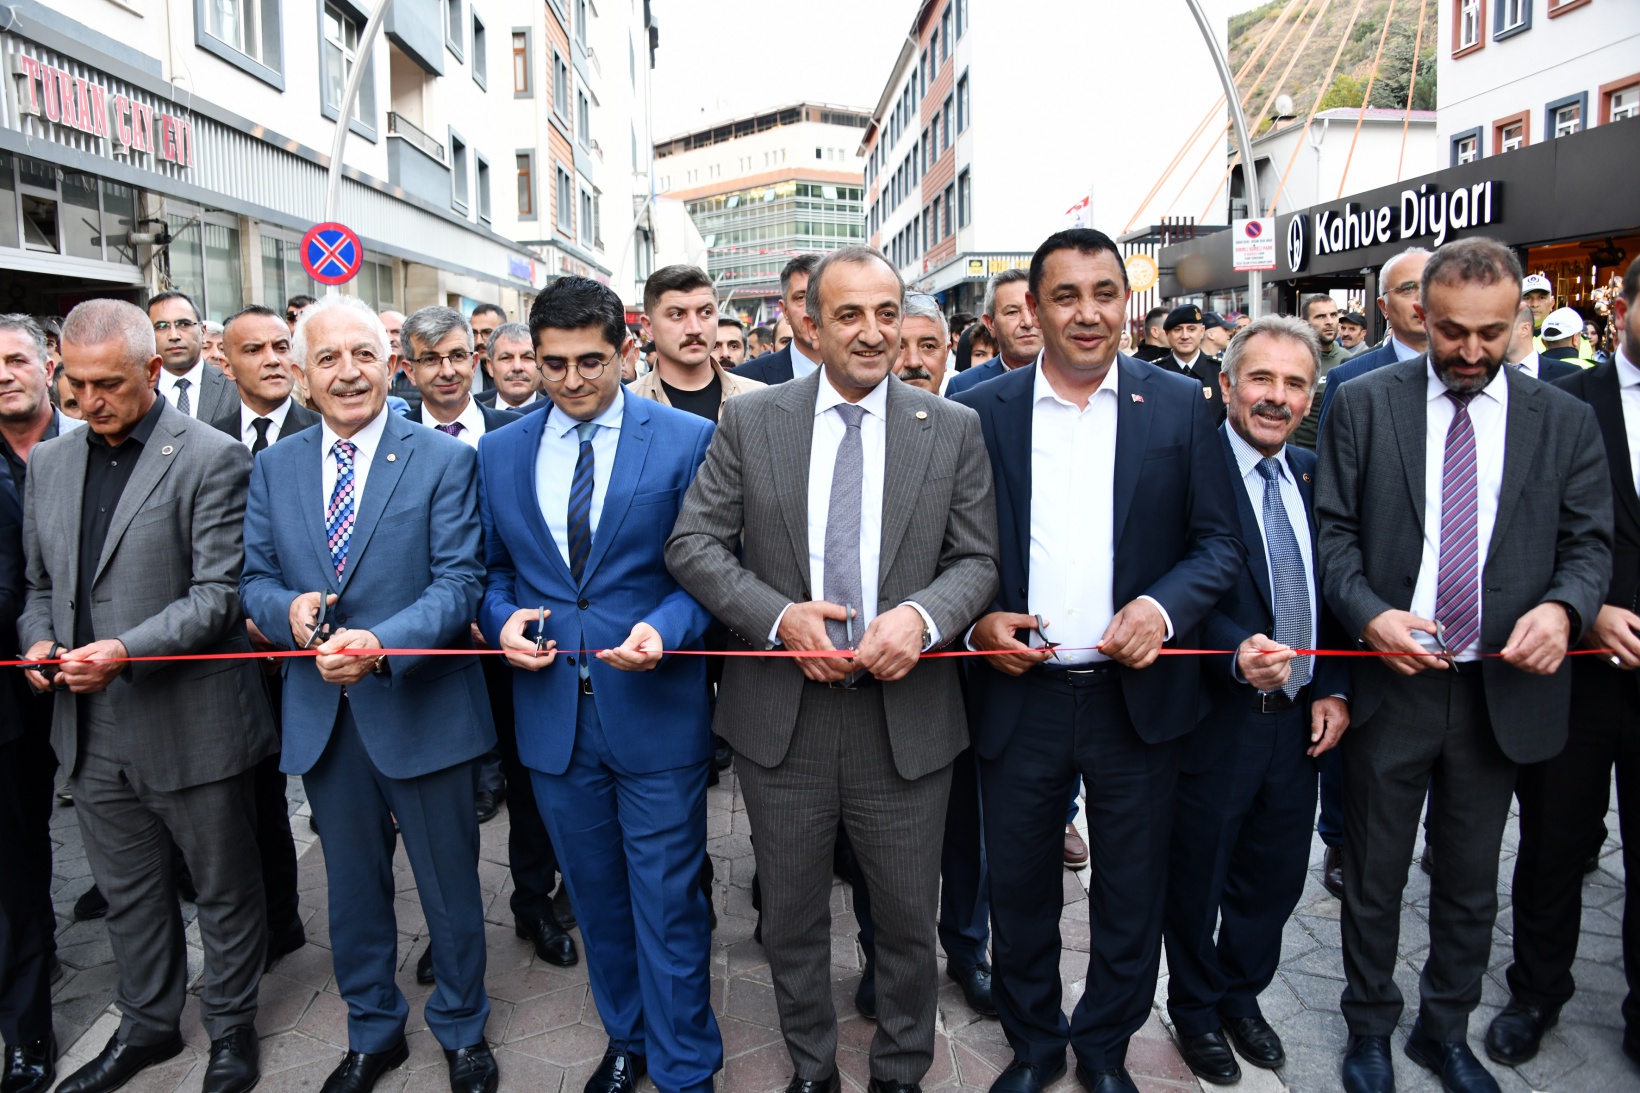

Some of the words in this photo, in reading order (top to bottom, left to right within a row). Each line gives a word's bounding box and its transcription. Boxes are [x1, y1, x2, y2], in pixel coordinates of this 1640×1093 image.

[21, 55, 108, 138] TURAN
[115, 93, 154, 155] ÇAY
[161, 113, 193, 168] EVİ
[1400, 180, 1493, 247] Diyarı
